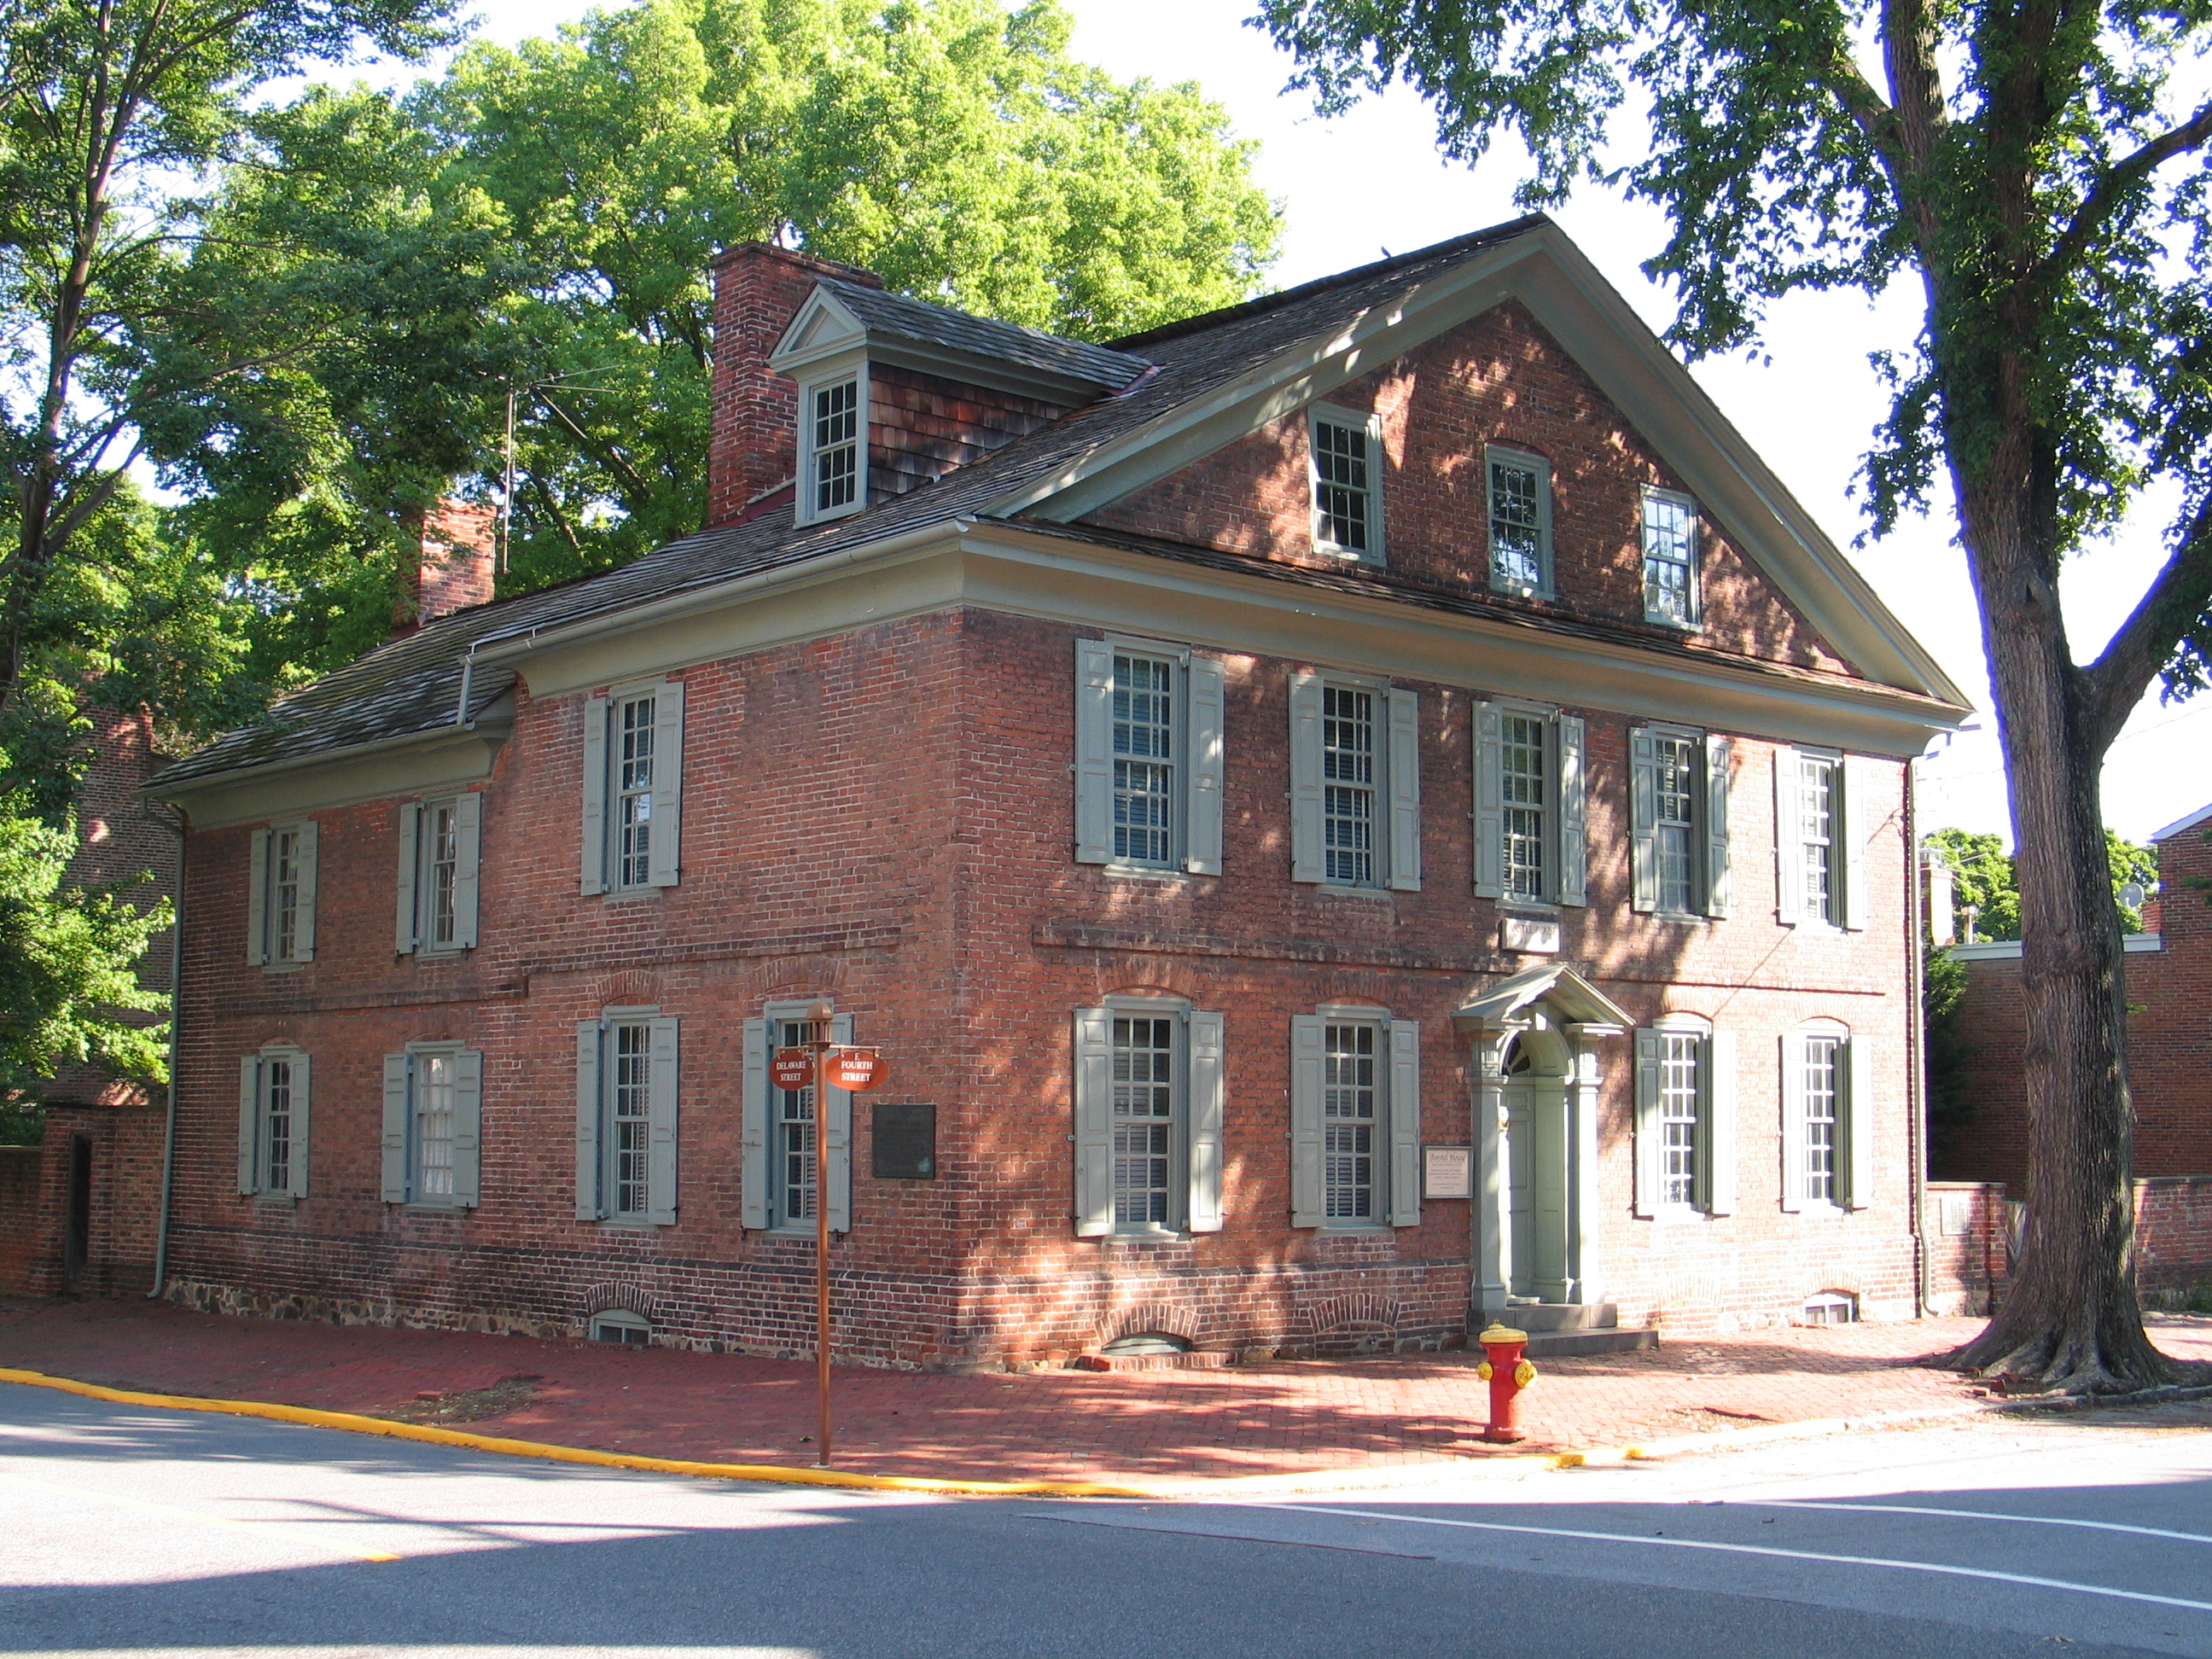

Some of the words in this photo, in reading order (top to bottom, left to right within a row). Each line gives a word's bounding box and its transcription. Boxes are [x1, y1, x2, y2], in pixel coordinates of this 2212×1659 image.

[777, 1061, 806, 1070] DELAWARE
[841, 1061, 873, 1069] FOURTH
[780, 1073, 802, 1081] STREET
[841, 1072, 871, 1081] STREET
